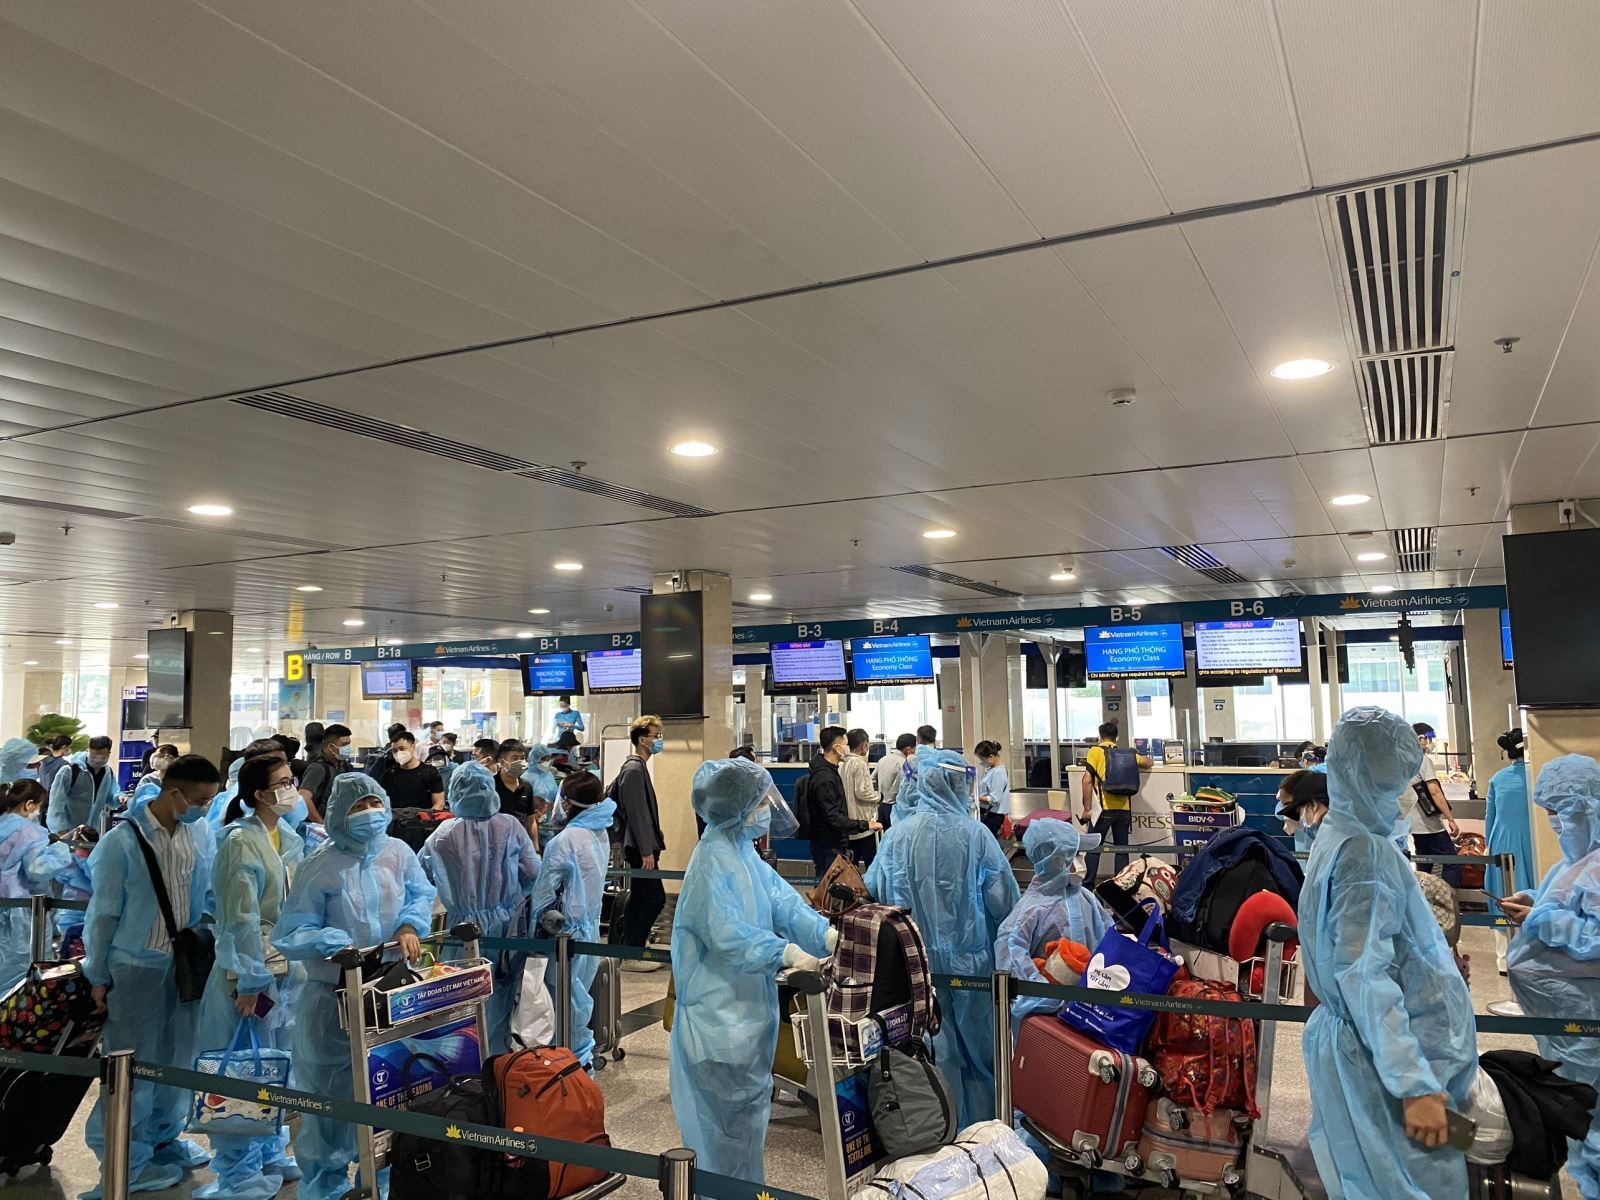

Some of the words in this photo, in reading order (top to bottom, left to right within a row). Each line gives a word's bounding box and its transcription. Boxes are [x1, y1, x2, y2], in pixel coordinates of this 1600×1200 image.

[1110, 606, 1142, 622] B-5
[1230, 600, 1265, 616] B-6
[798, 624, 822, 638] B-3
[873, 619, 899, 634] B-4
[540, 637, 559, 650] B-1
[612, 634, 633, 647] B-2
[325, 652, 340, 660] ROW
[344, 649, 352, 660] B
[377, 647, 401, 658] B-1a
[1110, 655, 1141, 663] Economy
[287, 654, 304, 681] B
[1188, 815, 1206, 823] BIDV
